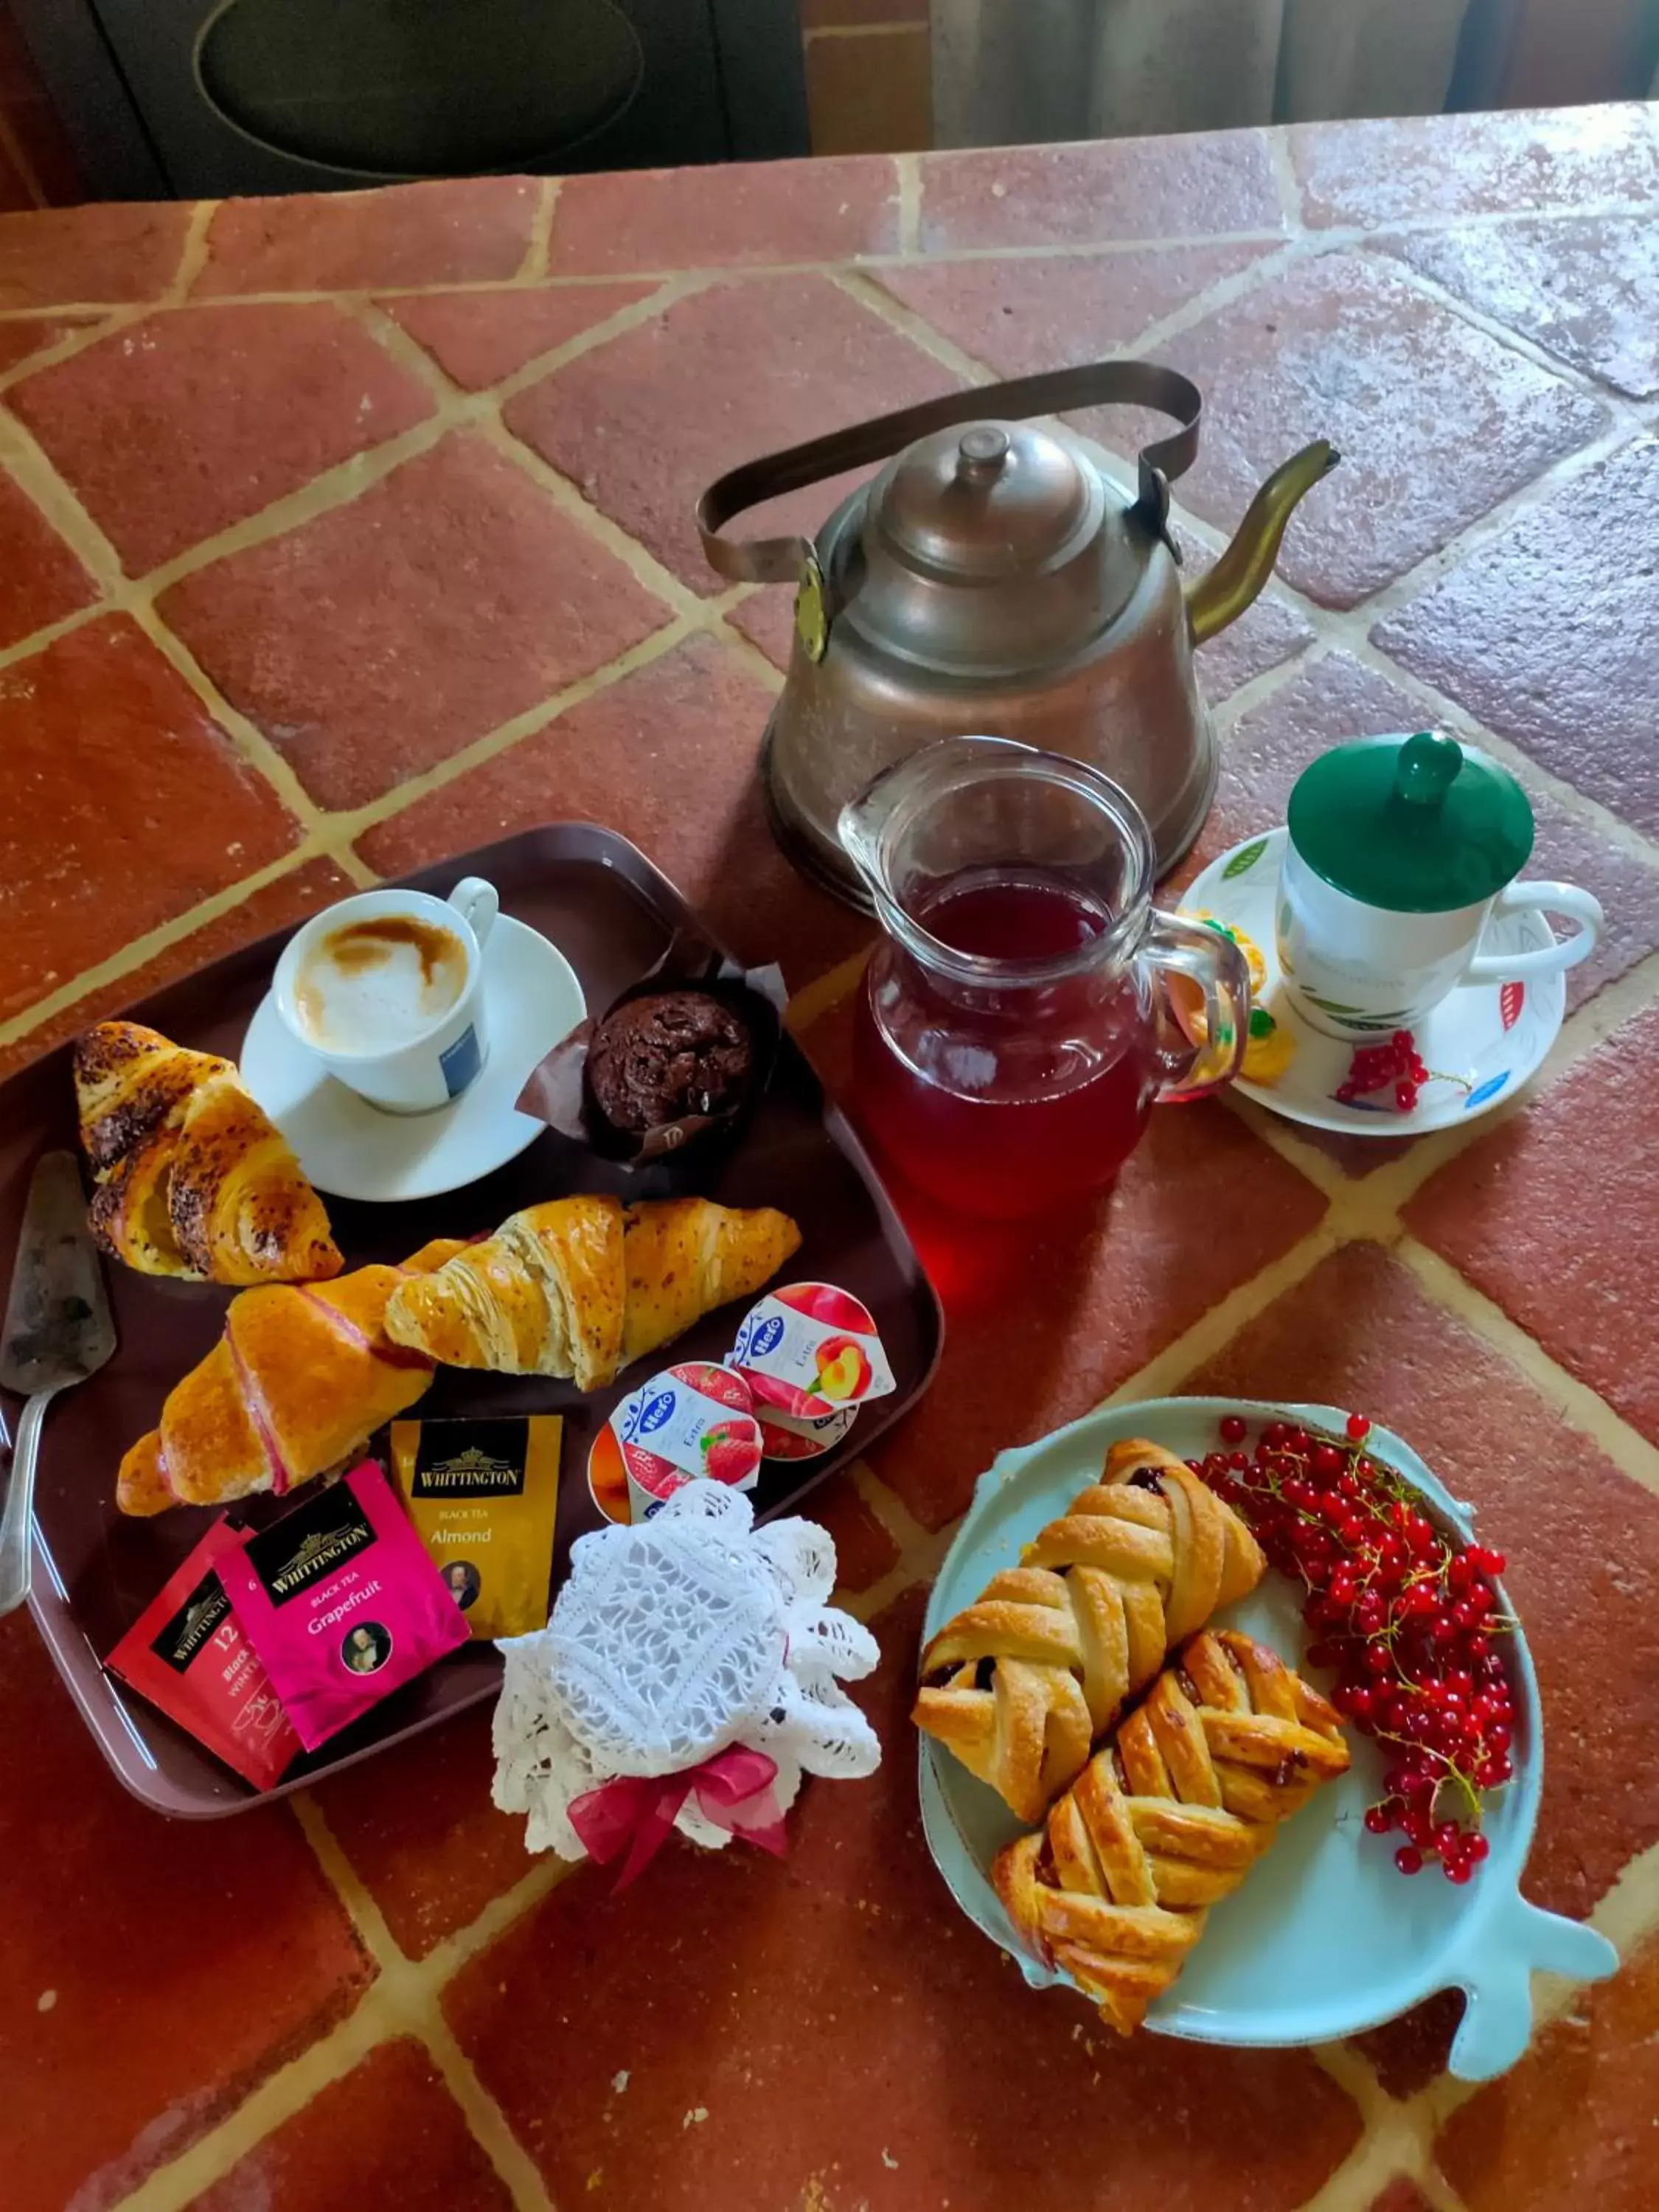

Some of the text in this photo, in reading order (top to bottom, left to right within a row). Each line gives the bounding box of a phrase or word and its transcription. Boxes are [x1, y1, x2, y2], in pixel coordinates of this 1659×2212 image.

[754, 1318, 781, 1354] Hero
[642, 1394, 672, 1430] Hero
[684, 1416, 706, 1447] Extra
[420, 1469, 518, 1488] WHITTINGTON
[438, 1509, 489, 1520] BLACK TEA
[430, 1527, 493, 1544] Almond
[271, 1526, 369, 1594] WHITTINGTON
[247, 1579, 257, 1591] 6
[310, 1571, 360, 1608] BLACK TEA
[307, 1579, 383, 1635] Grapefruit
[213, 1624, 239, 1652] 12
[223, 1649, 251, 1683] Black
